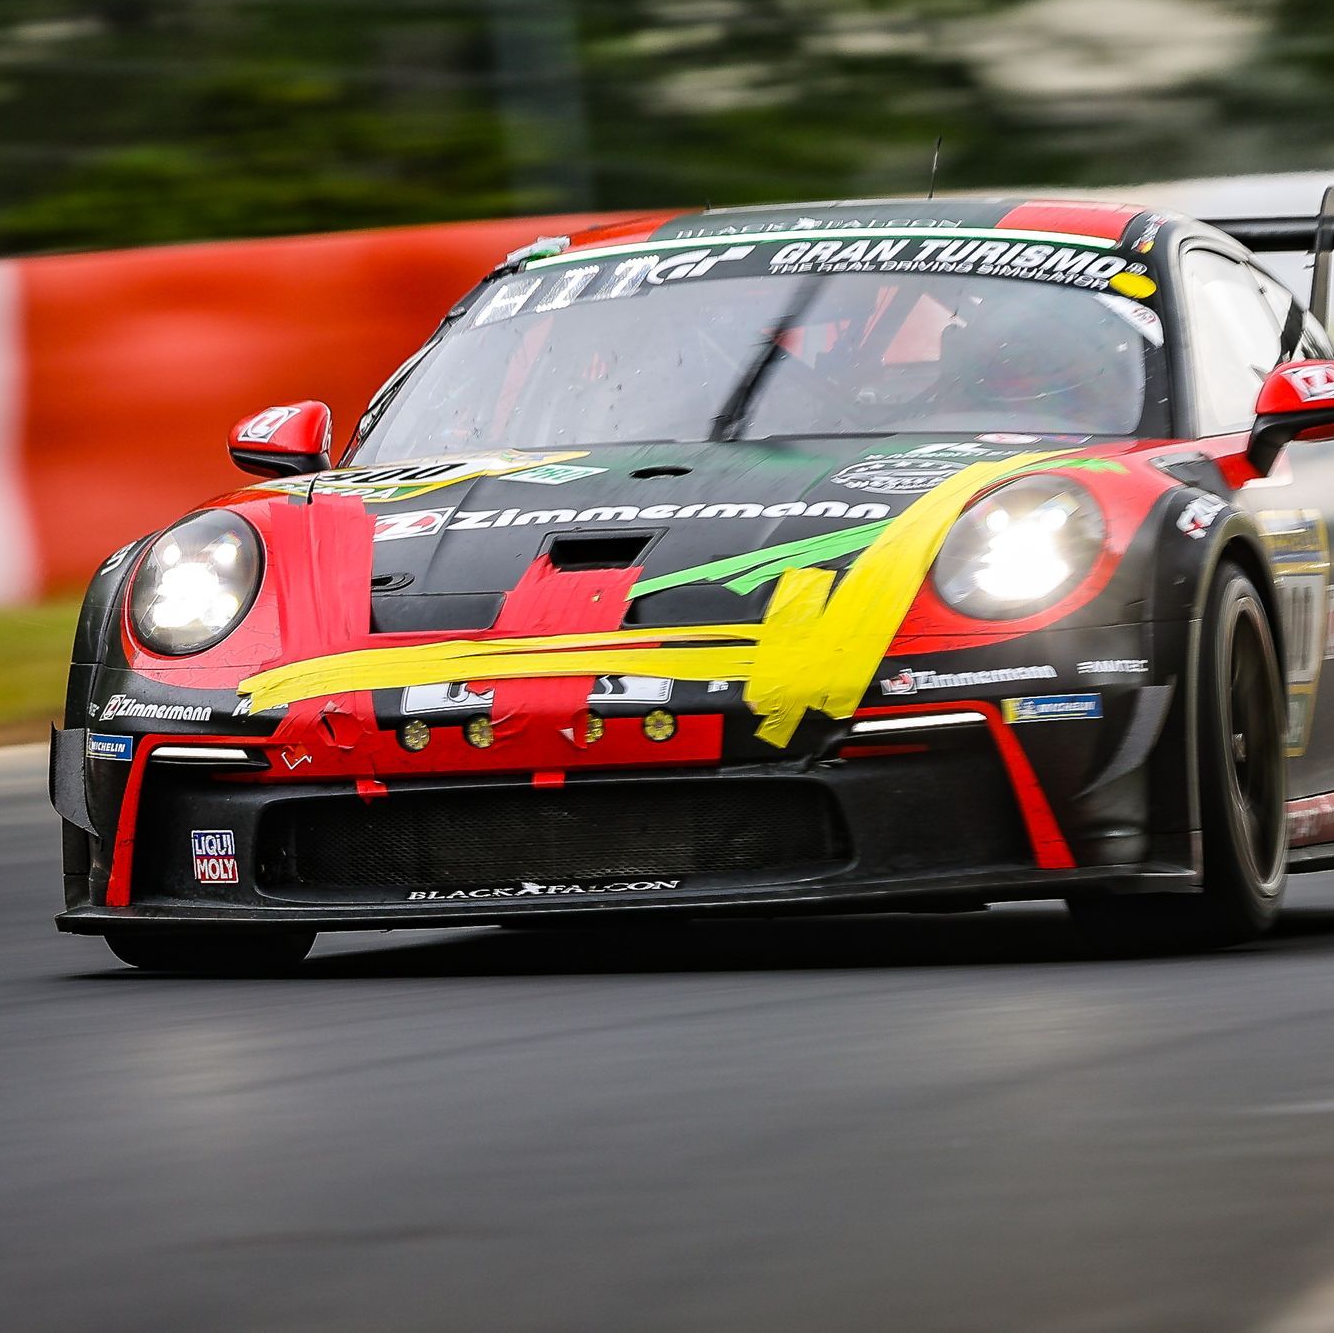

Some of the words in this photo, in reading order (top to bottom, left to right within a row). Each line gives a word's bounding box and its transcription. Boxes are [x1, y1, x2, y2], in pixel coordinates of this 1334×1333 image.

[769, 239, 912, 267] GRAN
[768, 262, 814, 275] THE
[815, 261, 876, 274] REAL
[878, 260, 975, 274] DRIVING
[976, 263, 1110, 291] SIMULATOR
[446, 500, 892, 530] Zimmermann
[912, 664, 1058, 690] Zimmermann
[117, 697, 212, 721] Zimmermann
[91, 741, 126, 754] MICHELIN
[196, 858, 235, 880] MOLY
[407, 887, 516, 901] BLACK
[545, 880, 681, 895] FALCON
